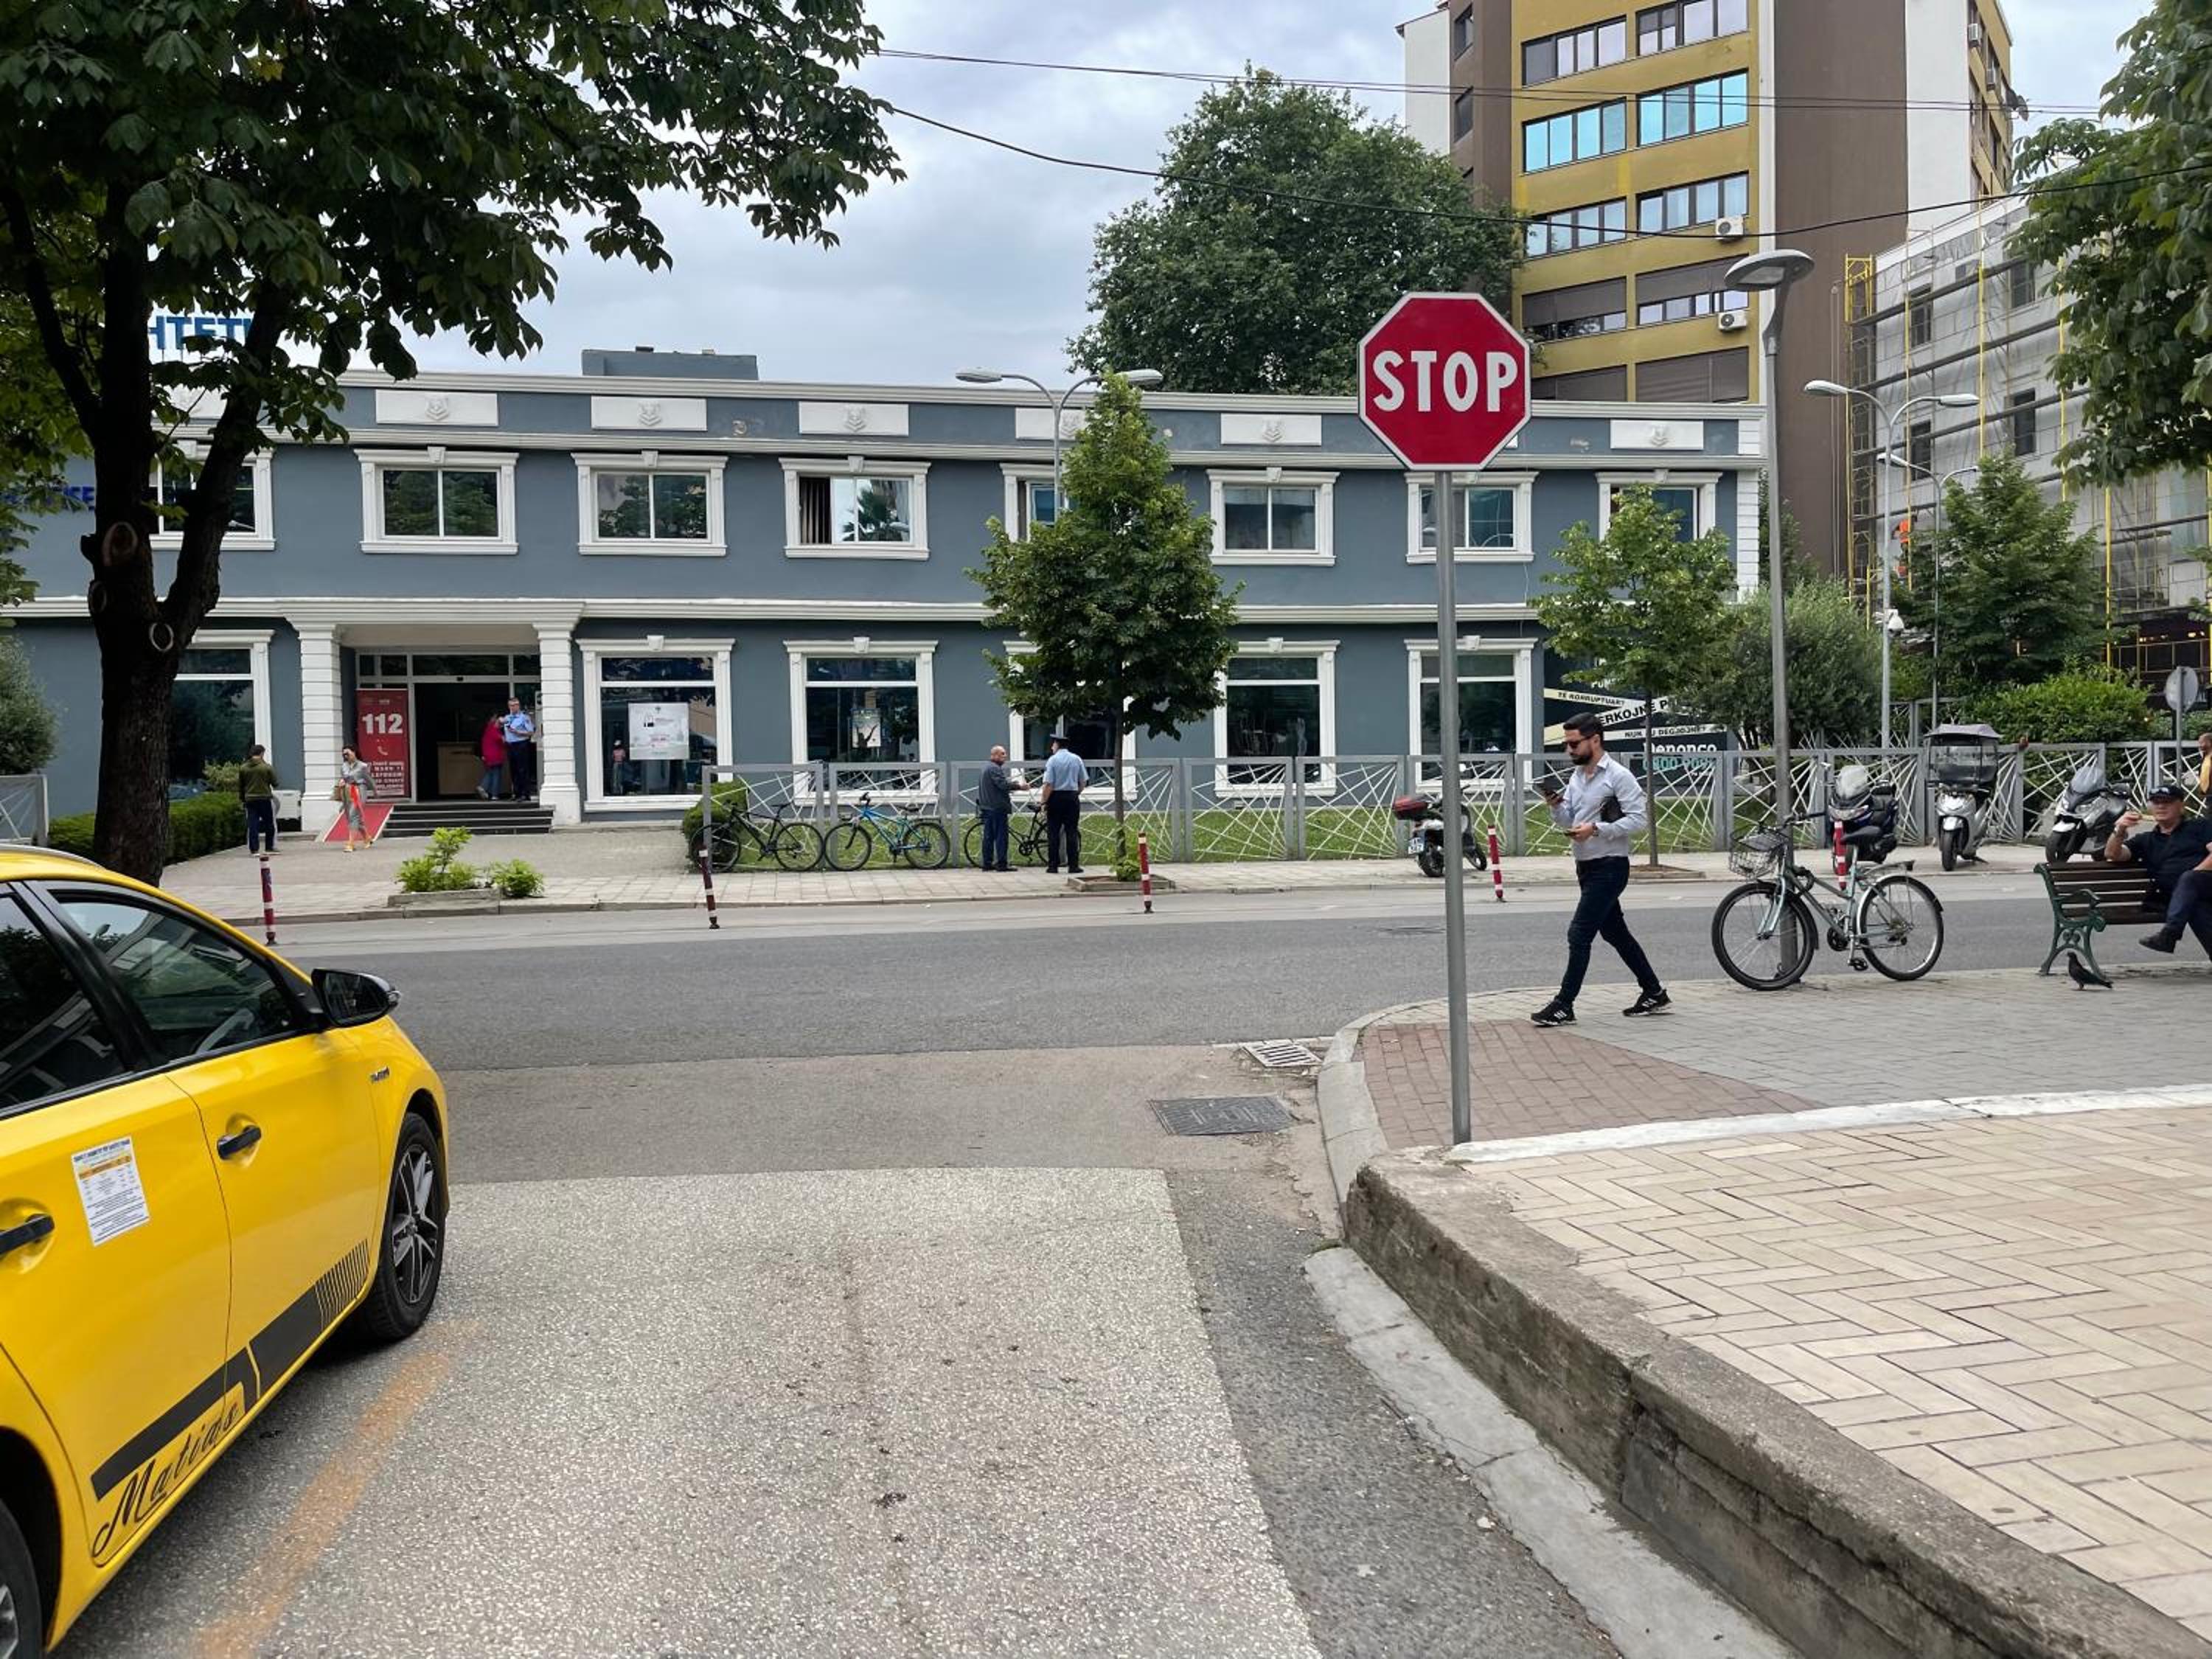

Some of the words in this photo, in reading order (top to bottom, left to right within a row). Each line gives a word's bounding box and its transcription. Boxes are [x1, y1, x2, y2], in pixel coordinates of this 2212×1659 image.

[1372, 350, 1518, 412] STOP
[362, 713, 403, 734] 112
[92, 1402, 239, 1558] Matias
